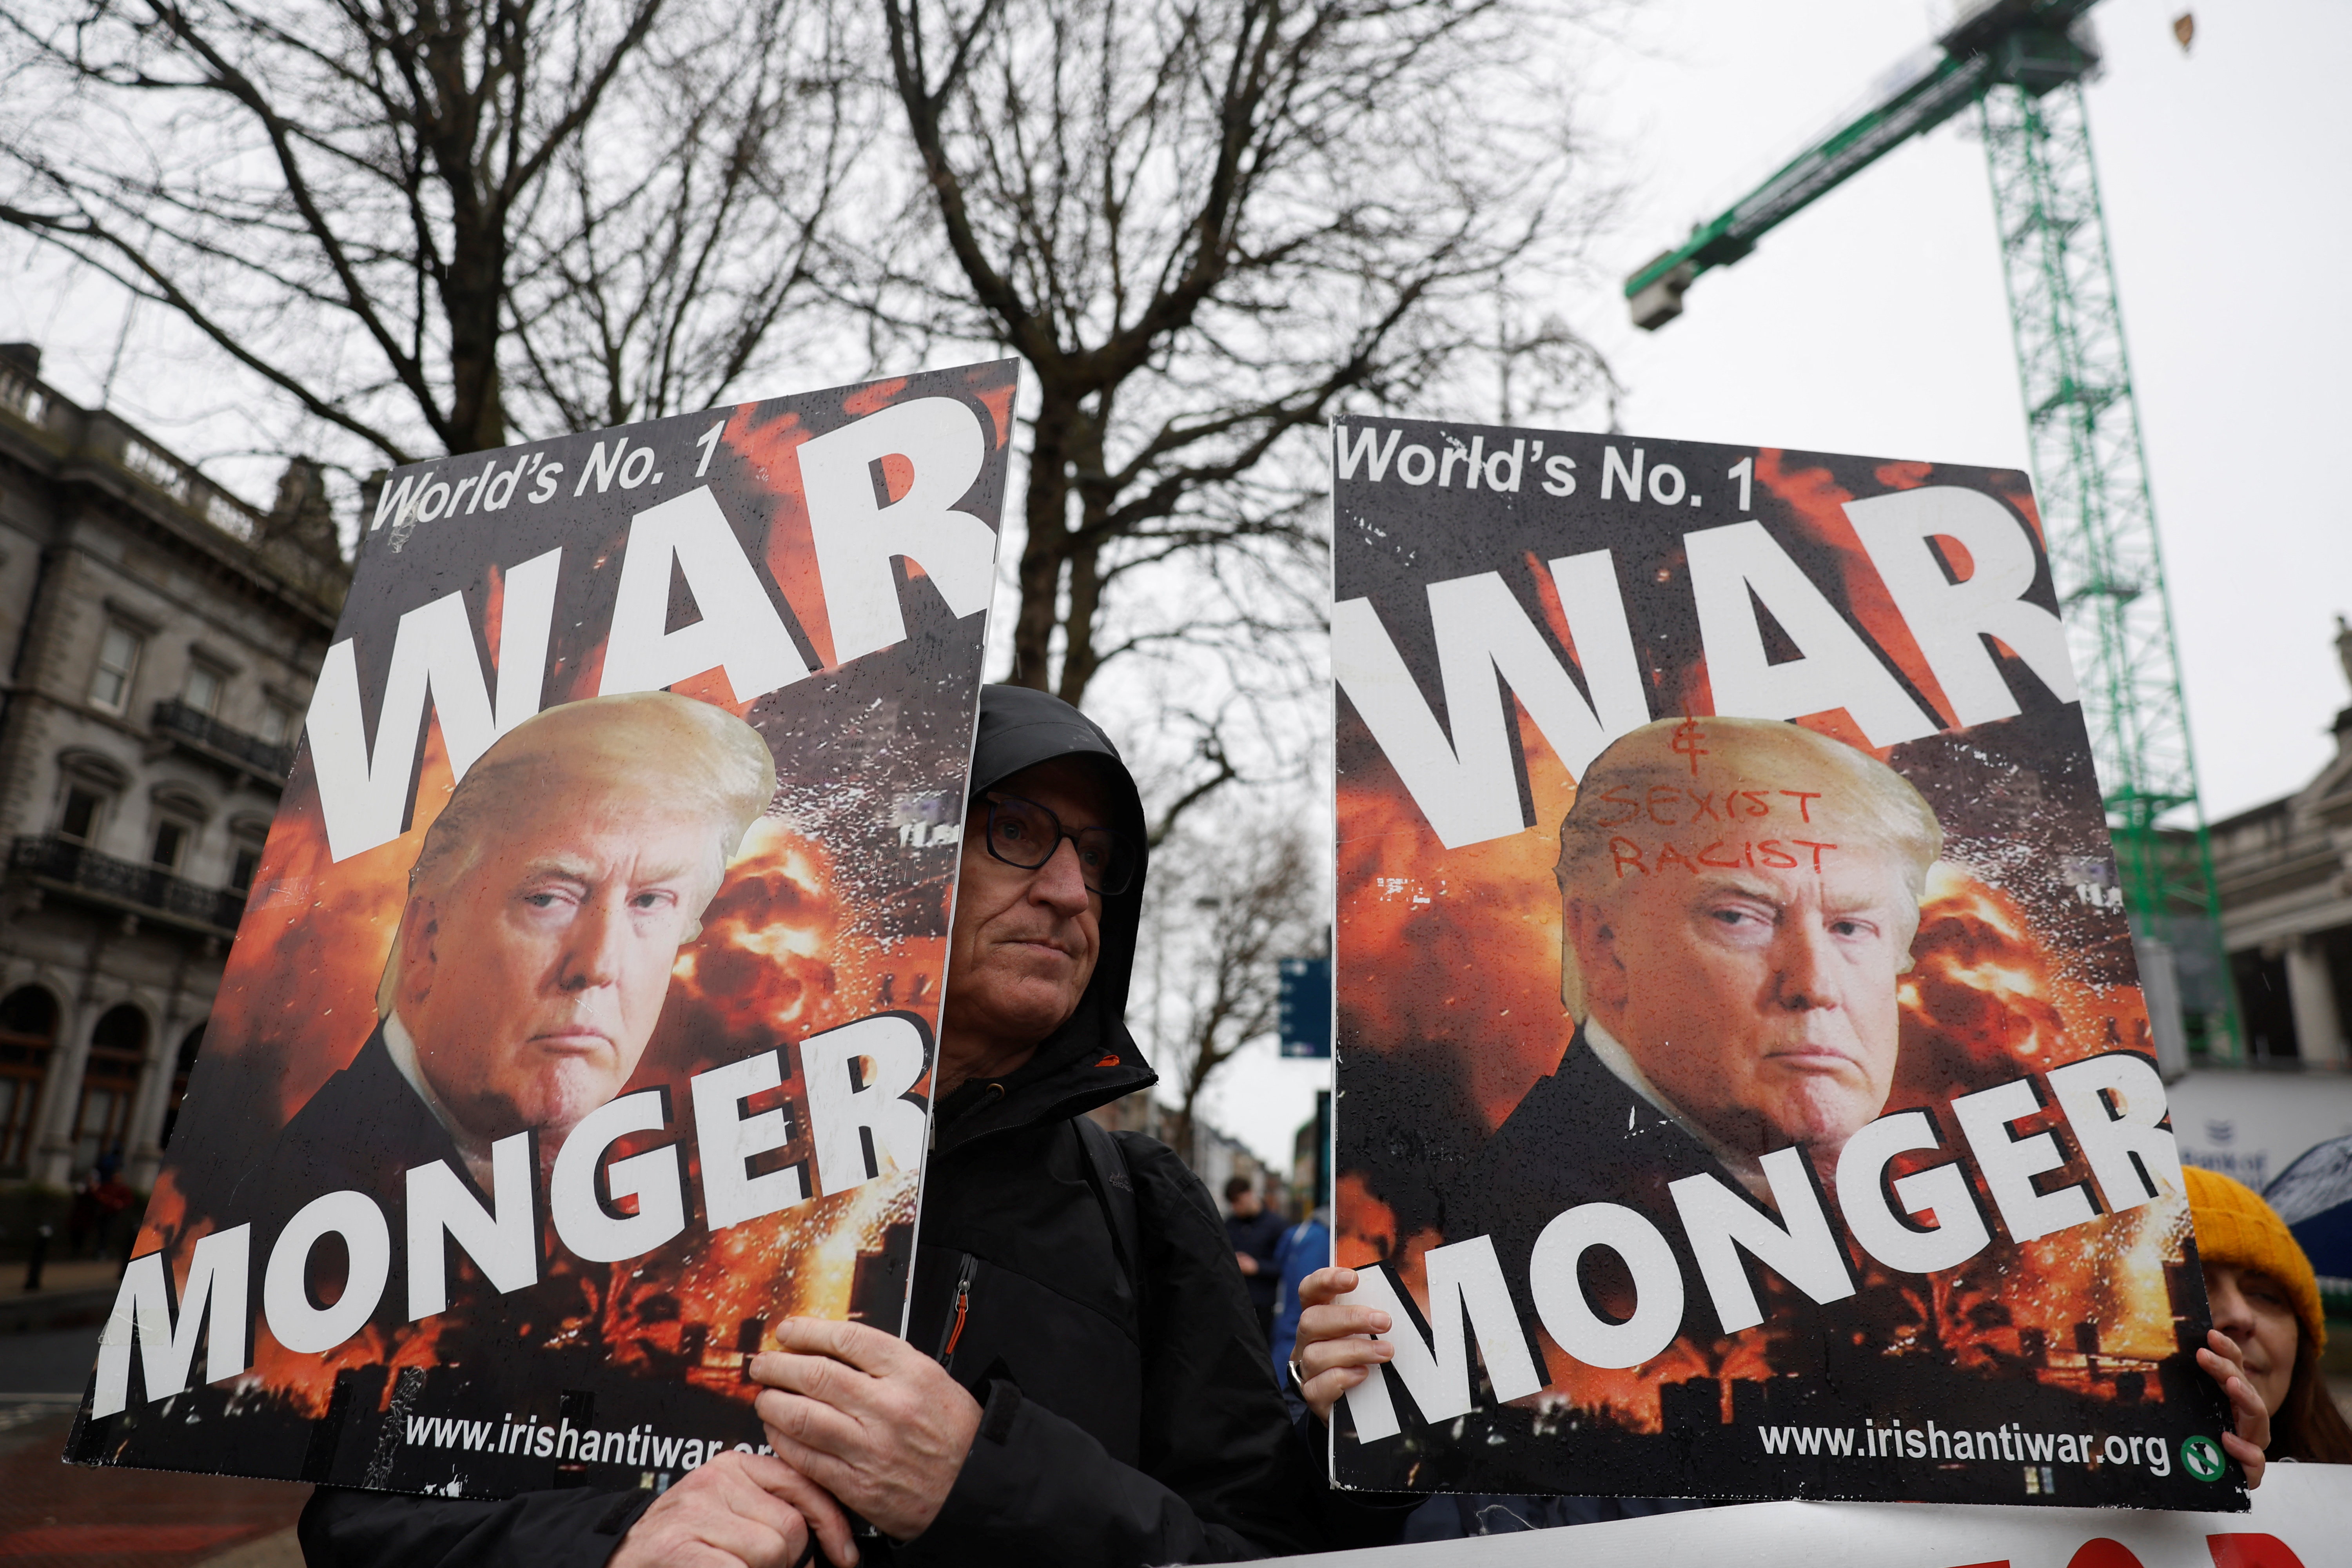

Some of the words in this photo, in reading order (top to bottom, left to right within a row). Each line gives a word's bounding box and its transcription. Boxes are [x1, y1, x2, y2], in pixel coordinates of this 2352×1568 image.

[371, 452, 563, 531] World's
[573, 437, 663, 497] No.
[695, 420, 726, 477] 1
[1336, 425, 1577, 496] World's
[1601, 446, 1702, 507] No.
[1728, 457, 1752, 511] 1
[306, 396, 997, 863] WAR
[1335, 485, 2080, 849] WAR
[1597, 785, 1821, 827] SEXIST
[1609, 836, 1838, 878] RACIST
[93, 1015, 927, 1421] MONGER
[1336, 1053, 2182, 1445] MONGER
[1758, 1419, 2172, 1476] www.irishantiwar.org
